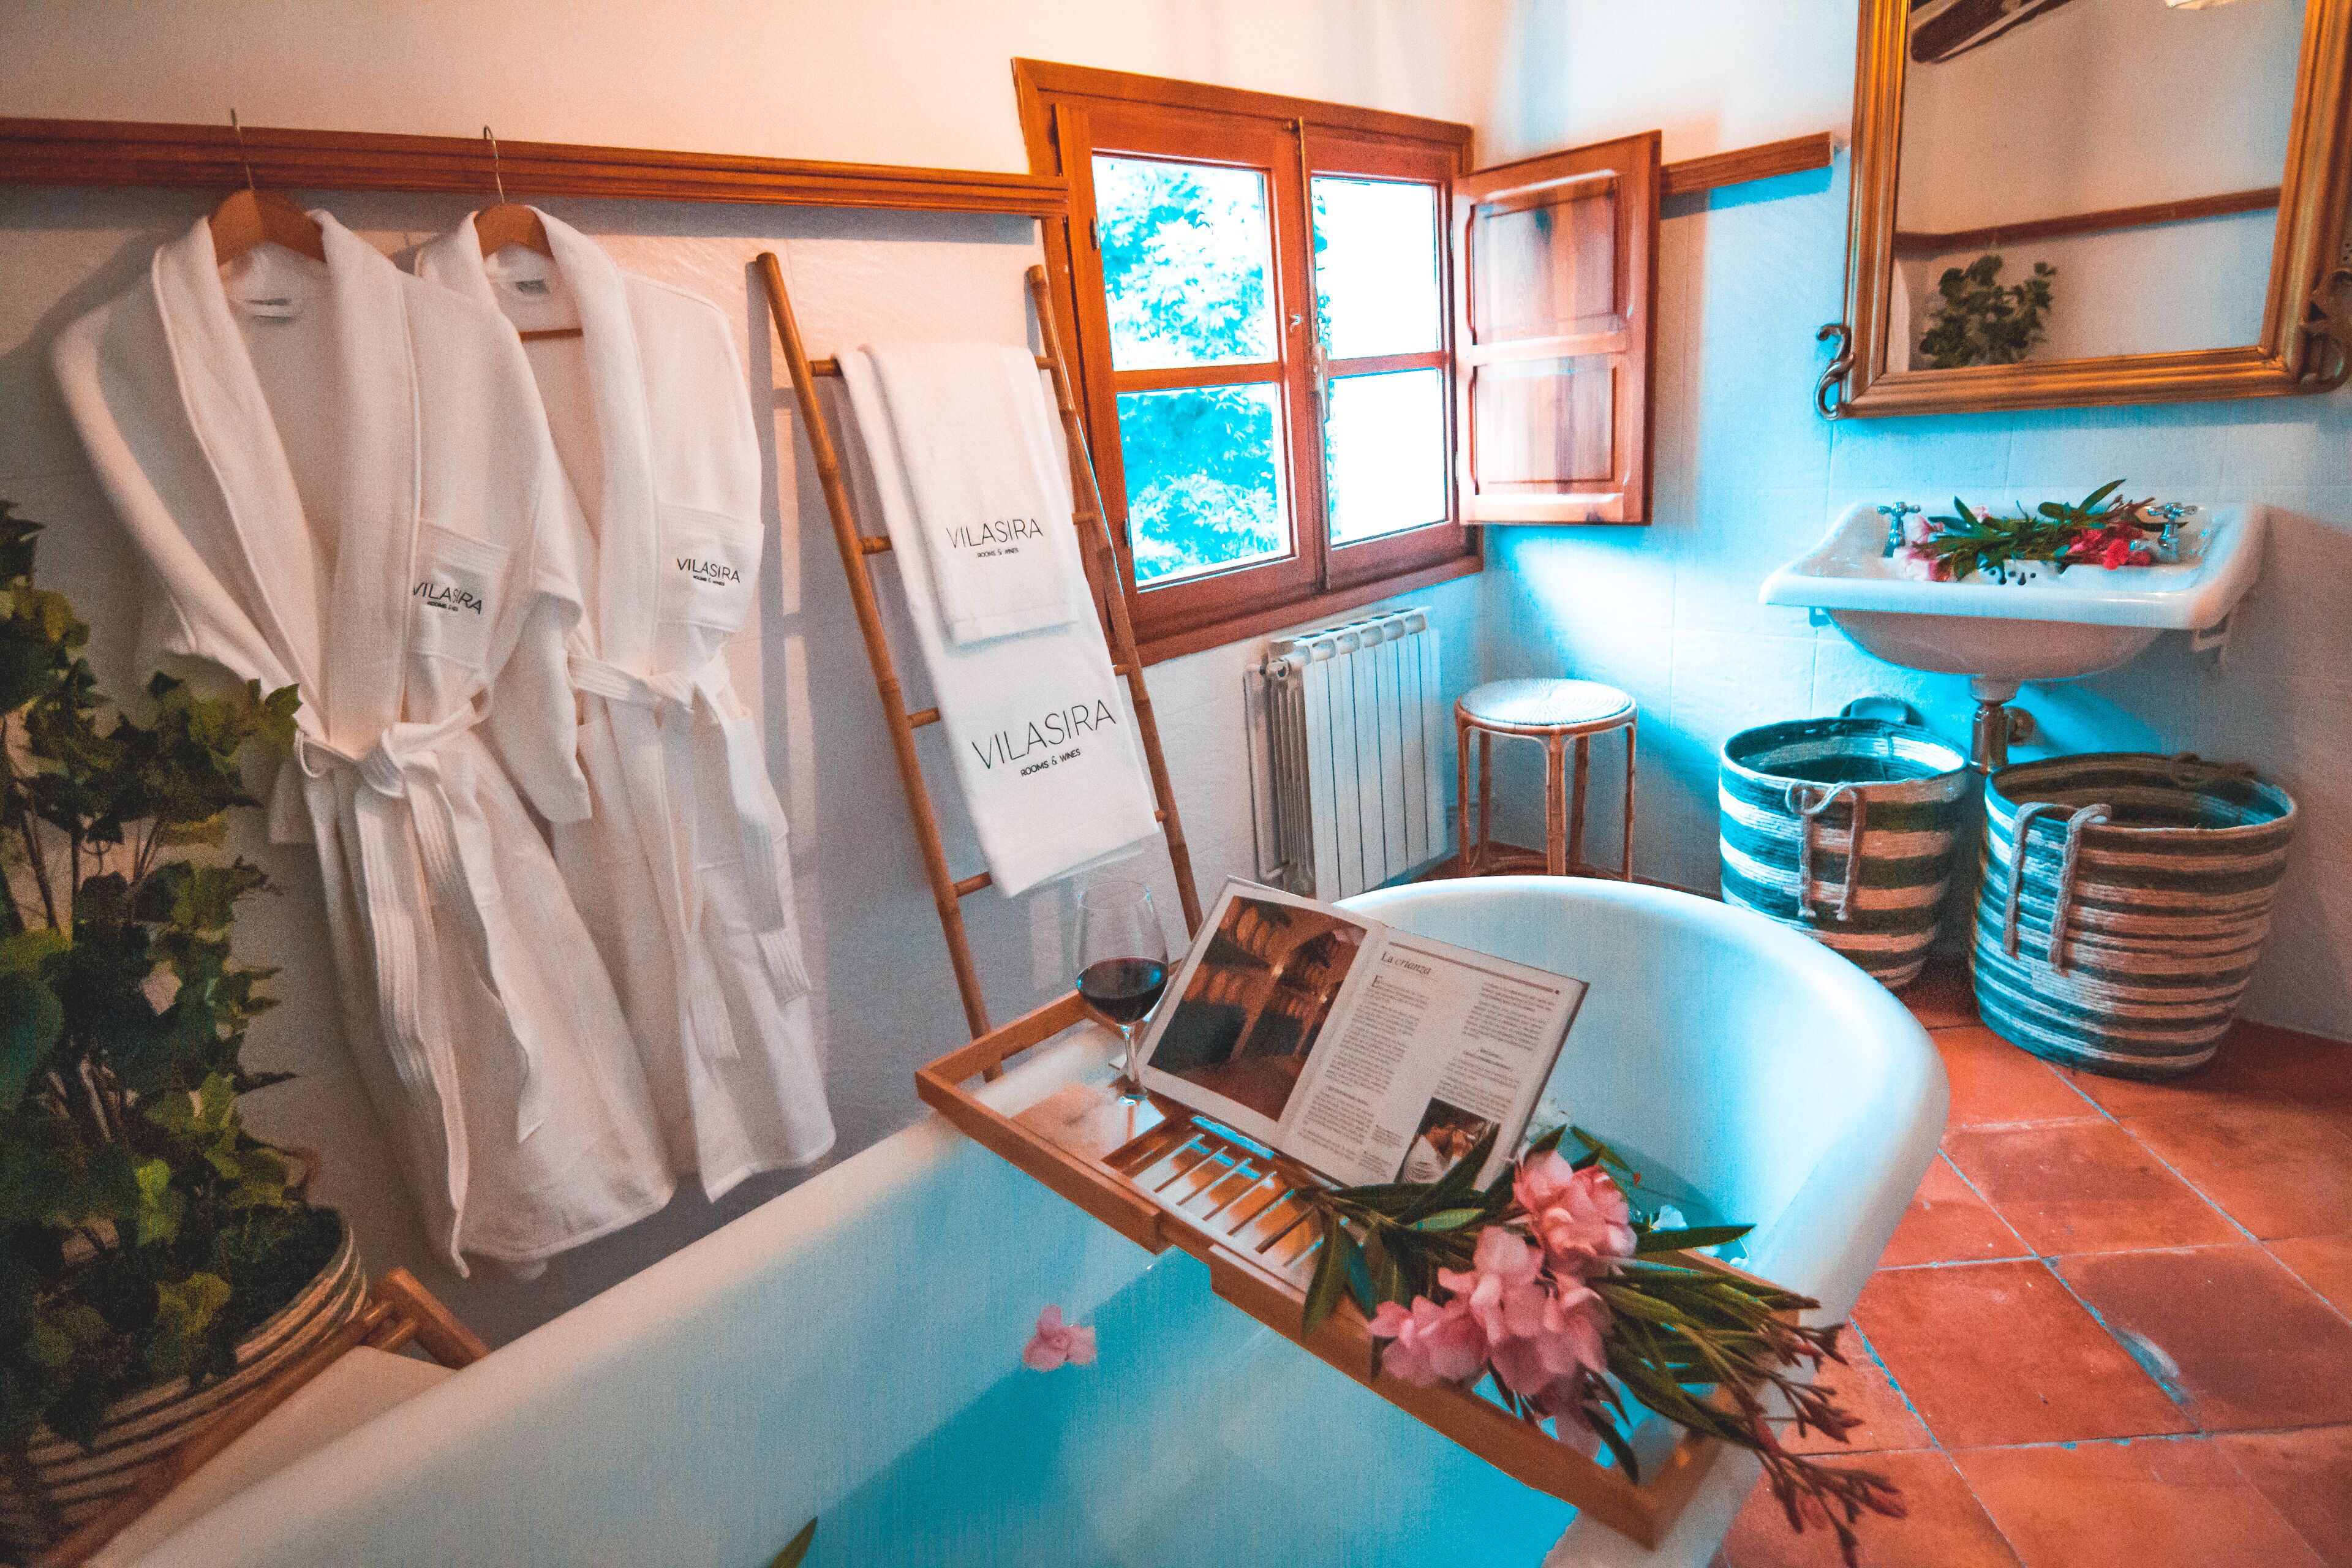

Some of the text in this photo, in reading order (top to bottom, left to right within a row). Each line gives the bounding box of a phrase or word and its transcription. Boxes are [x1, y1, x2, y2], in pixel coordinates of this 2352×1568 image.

[946, 518, 1044, 549] VILASIRA
[677, 558, 740, 583] VILASIRA
[413, 582, 482, 615] VILASIRA
[971, 699, 1117, 770] VILASIRA
[1020, 748, 1081, 777] ROOMS & WINES
[1380, 951, 1393, 963] La
